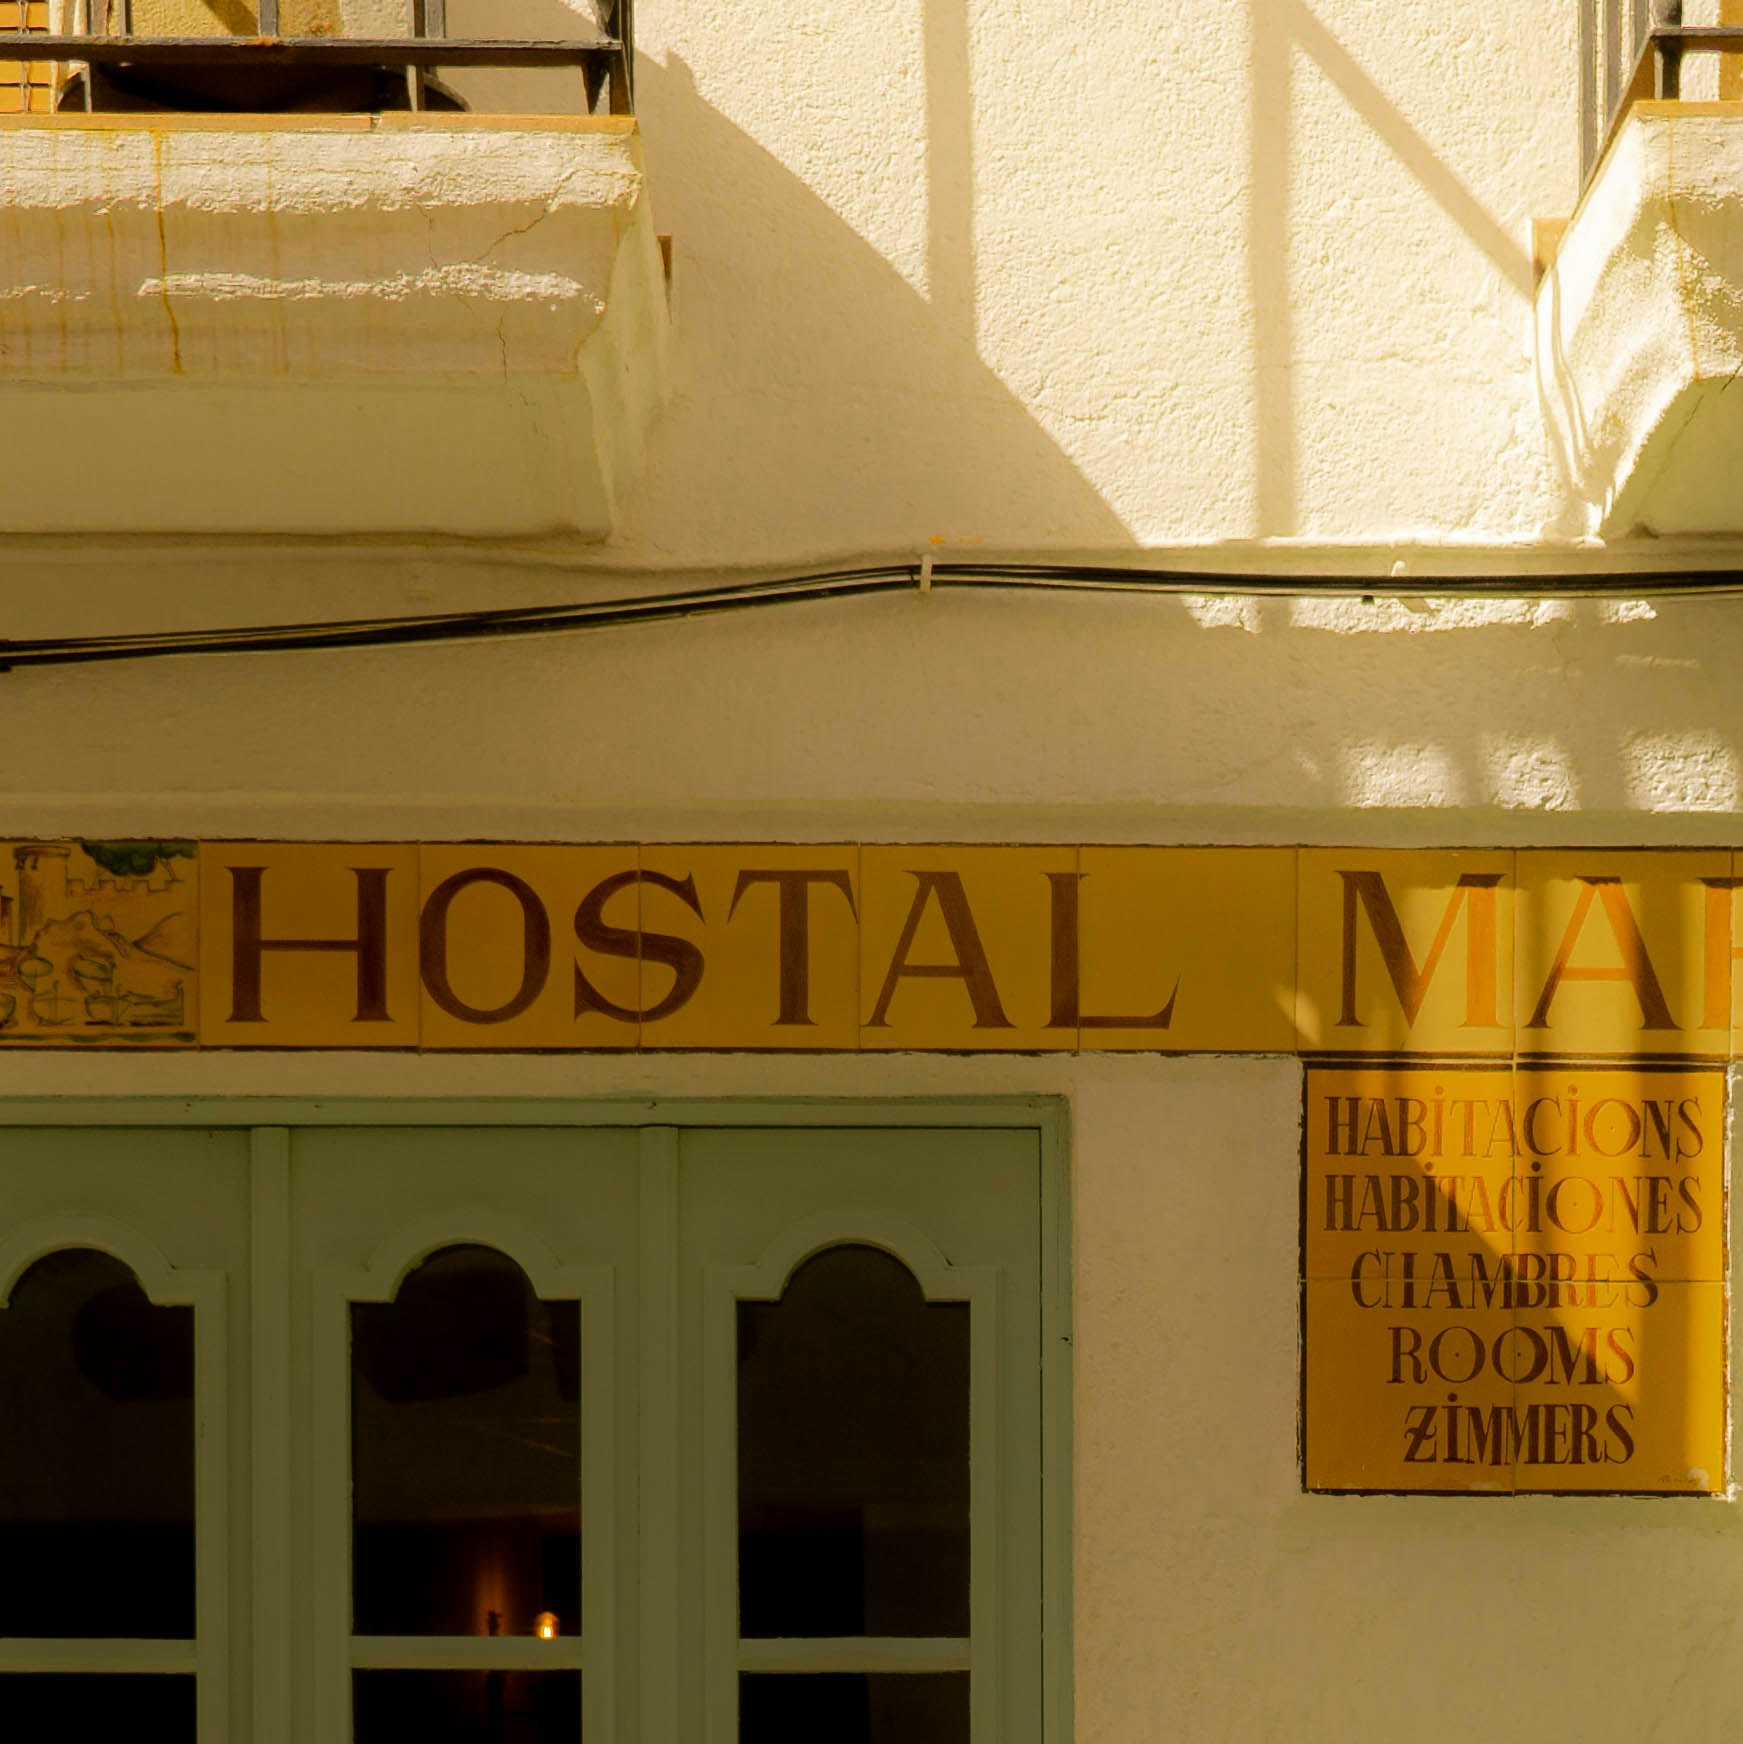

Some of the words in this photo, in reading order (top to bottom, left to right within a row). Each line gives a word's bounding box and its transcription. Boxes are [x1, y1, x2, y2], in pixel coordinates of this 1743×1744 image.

[222, 865, 1181, 1030] HOSTAL
[1323, 1085, 1704, 1164] HABITACIONS
[1322, 1161, 1703, 1235] HABITACIONES
[1351, 1248, 1658, 1310] CHAMBRES
[1386, 1326, 1635, 1386] ROOMS
